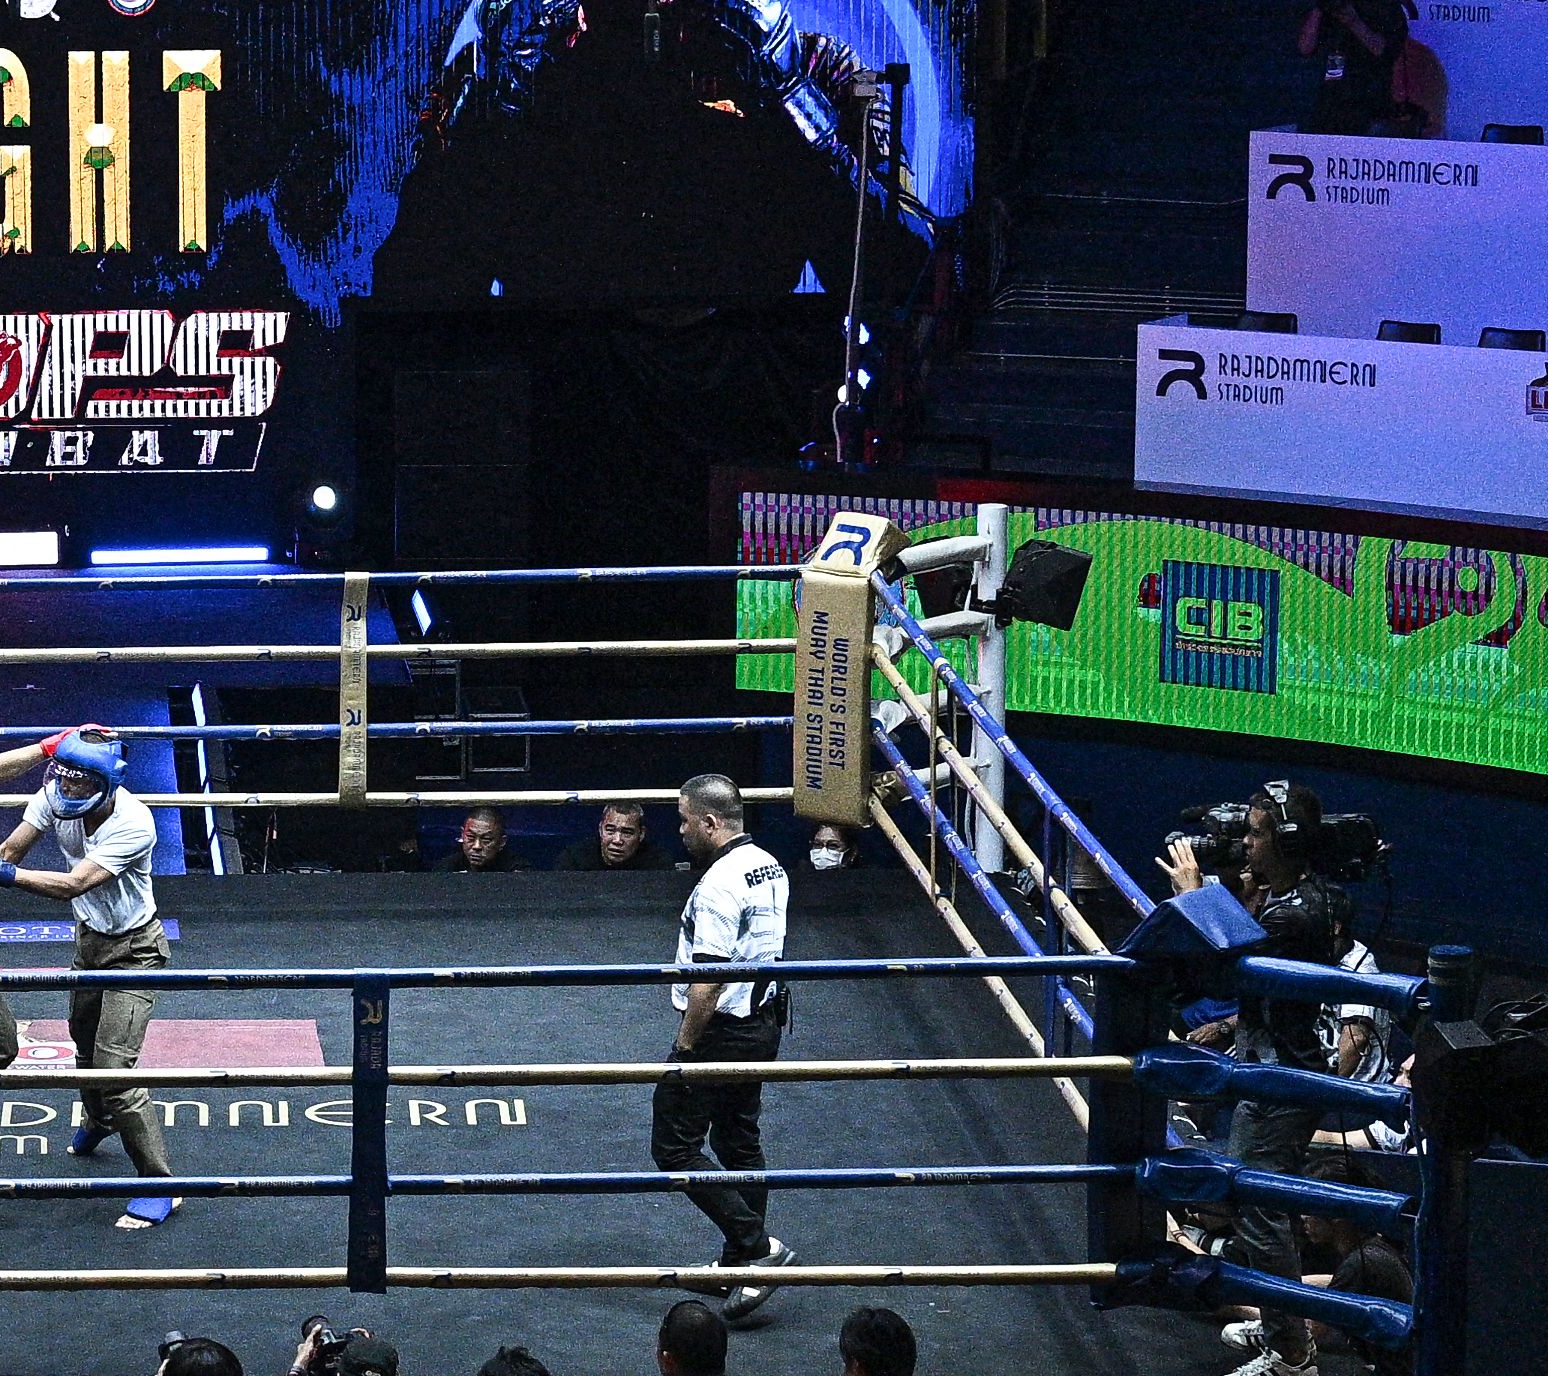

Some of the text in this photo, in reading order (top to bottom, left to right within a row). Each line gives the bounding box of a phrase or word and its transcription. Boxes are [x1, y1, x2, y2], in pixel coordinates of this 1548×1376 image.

[1428, 4, 1491, 23] STADIUM
[1325, 156, 1479, 187] RAJADAMNERN
[1324, 185, 1391, 206] STADIUM
[1217, 352, 1377, 388] RAJADAMNERN
[1217, 383, 1285, 406] STADIUM
[1175, 597, 1263, 639] CIB
[805, 610, 829, 790] MUAY THAI STADIUM
[828, 637, 850, 771] WORLD'S FIRST
